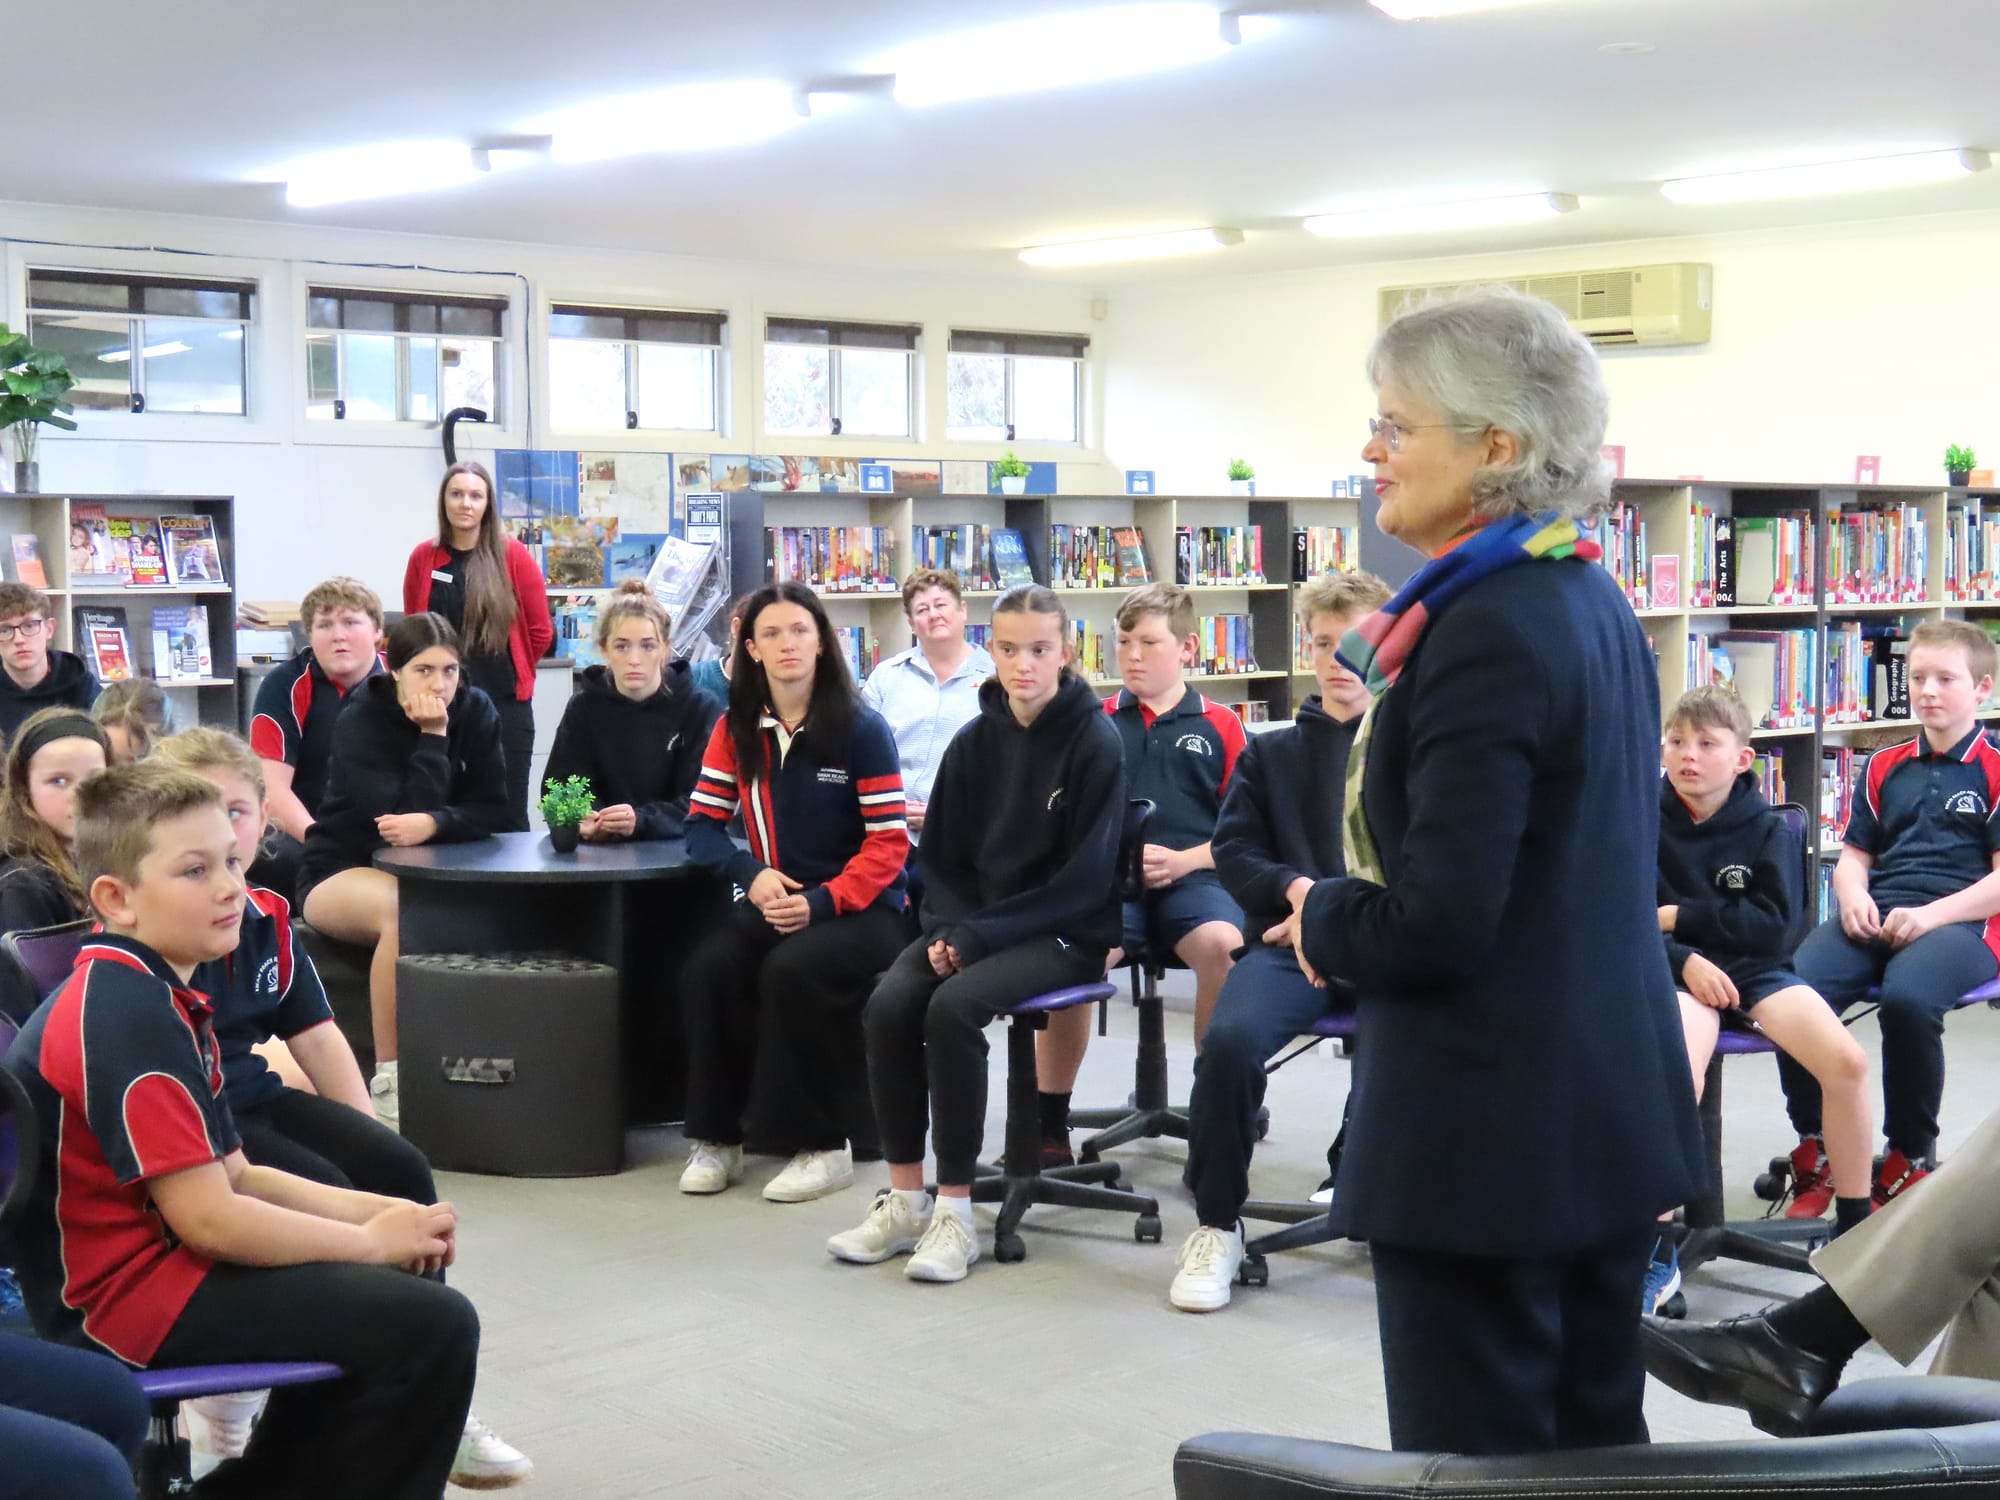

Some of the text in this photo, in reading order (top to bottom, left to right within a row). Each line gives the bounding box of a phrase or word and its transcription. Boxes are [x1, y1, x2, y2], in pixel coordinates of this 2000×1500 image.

[161, 519, 209, 529] COUNTRY
[995, 543, 1023, 554] NUNN
[1180, 535, 1189, 553] R
[1298, 535, 1306, 551] S
[1716, 593, 1733, 602] 700
[1890, 657, 1899, 702] Geography
[1891, 706, 1907, 714] 900
